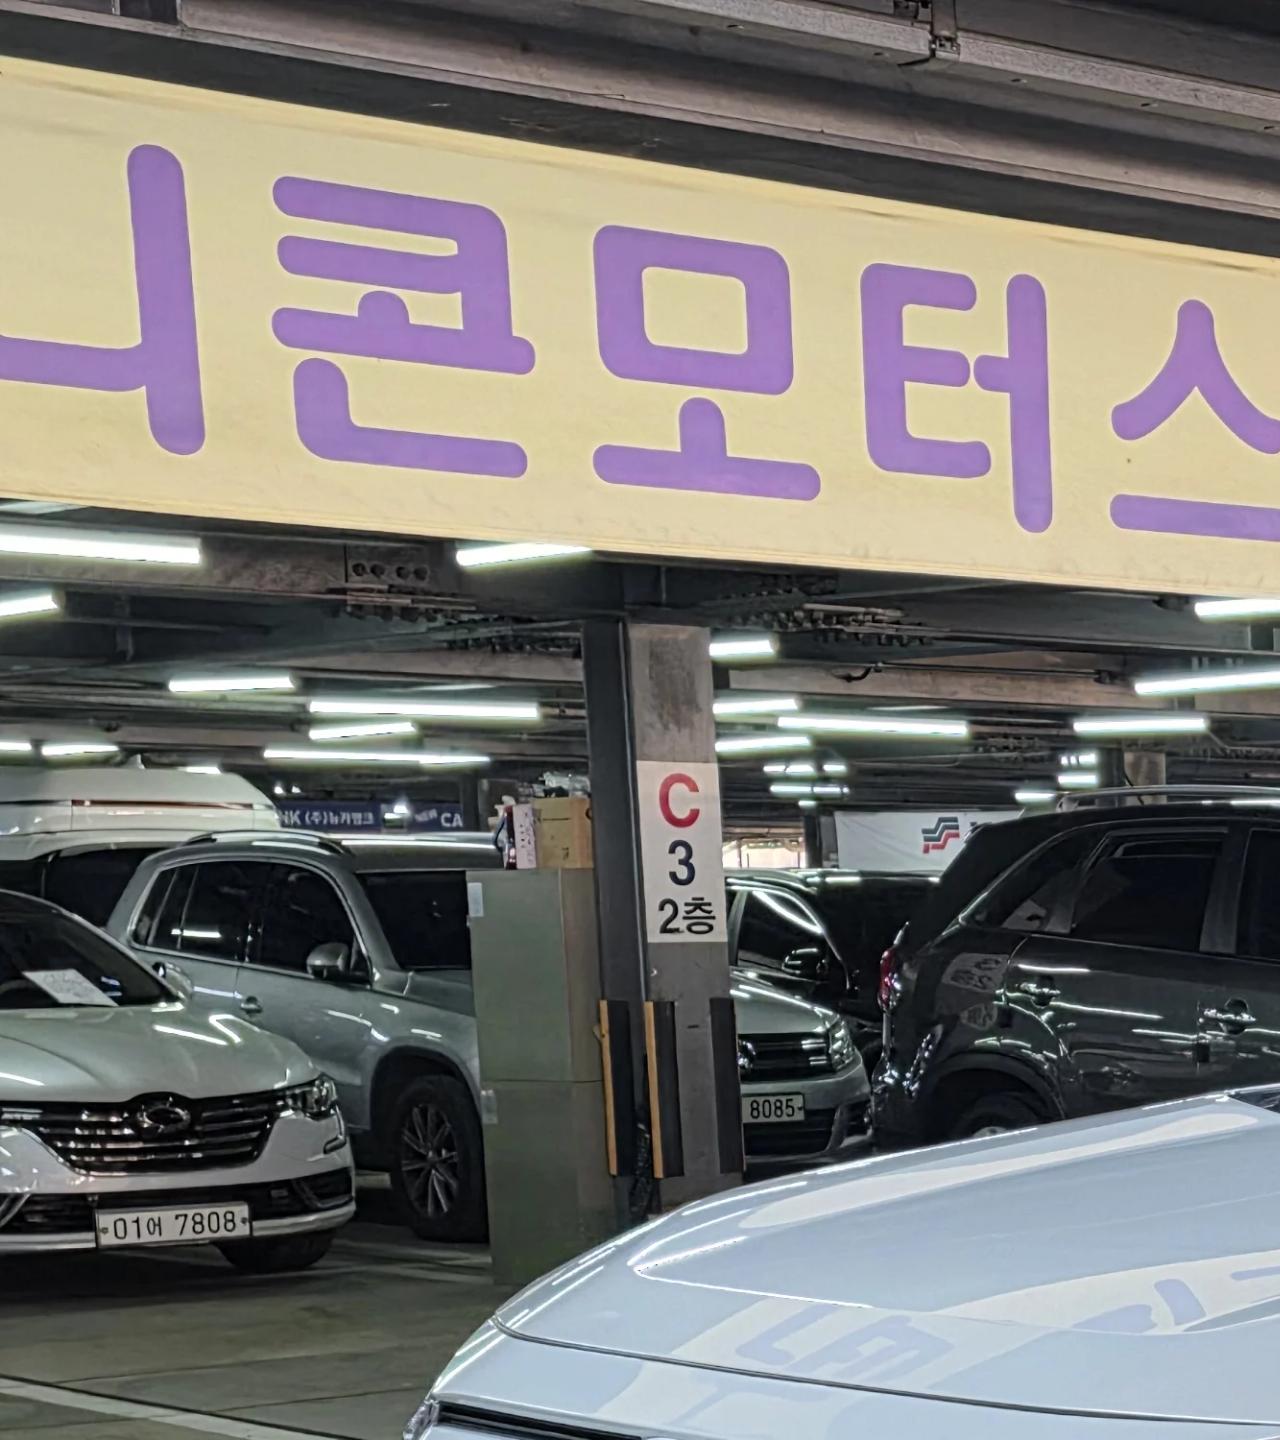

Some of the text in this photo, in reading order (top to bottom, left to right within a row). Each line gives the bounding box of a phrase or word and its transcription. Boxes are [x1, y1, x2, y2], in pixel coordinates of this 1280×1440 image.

[659, 773, 700, 828] C
[668, 840, 695, 886] 3
[658, 897, 716, 935] 2층
[750, 1098, 795, 1119] 8085
[113, 1210, 236, 1240] 01어 7808
